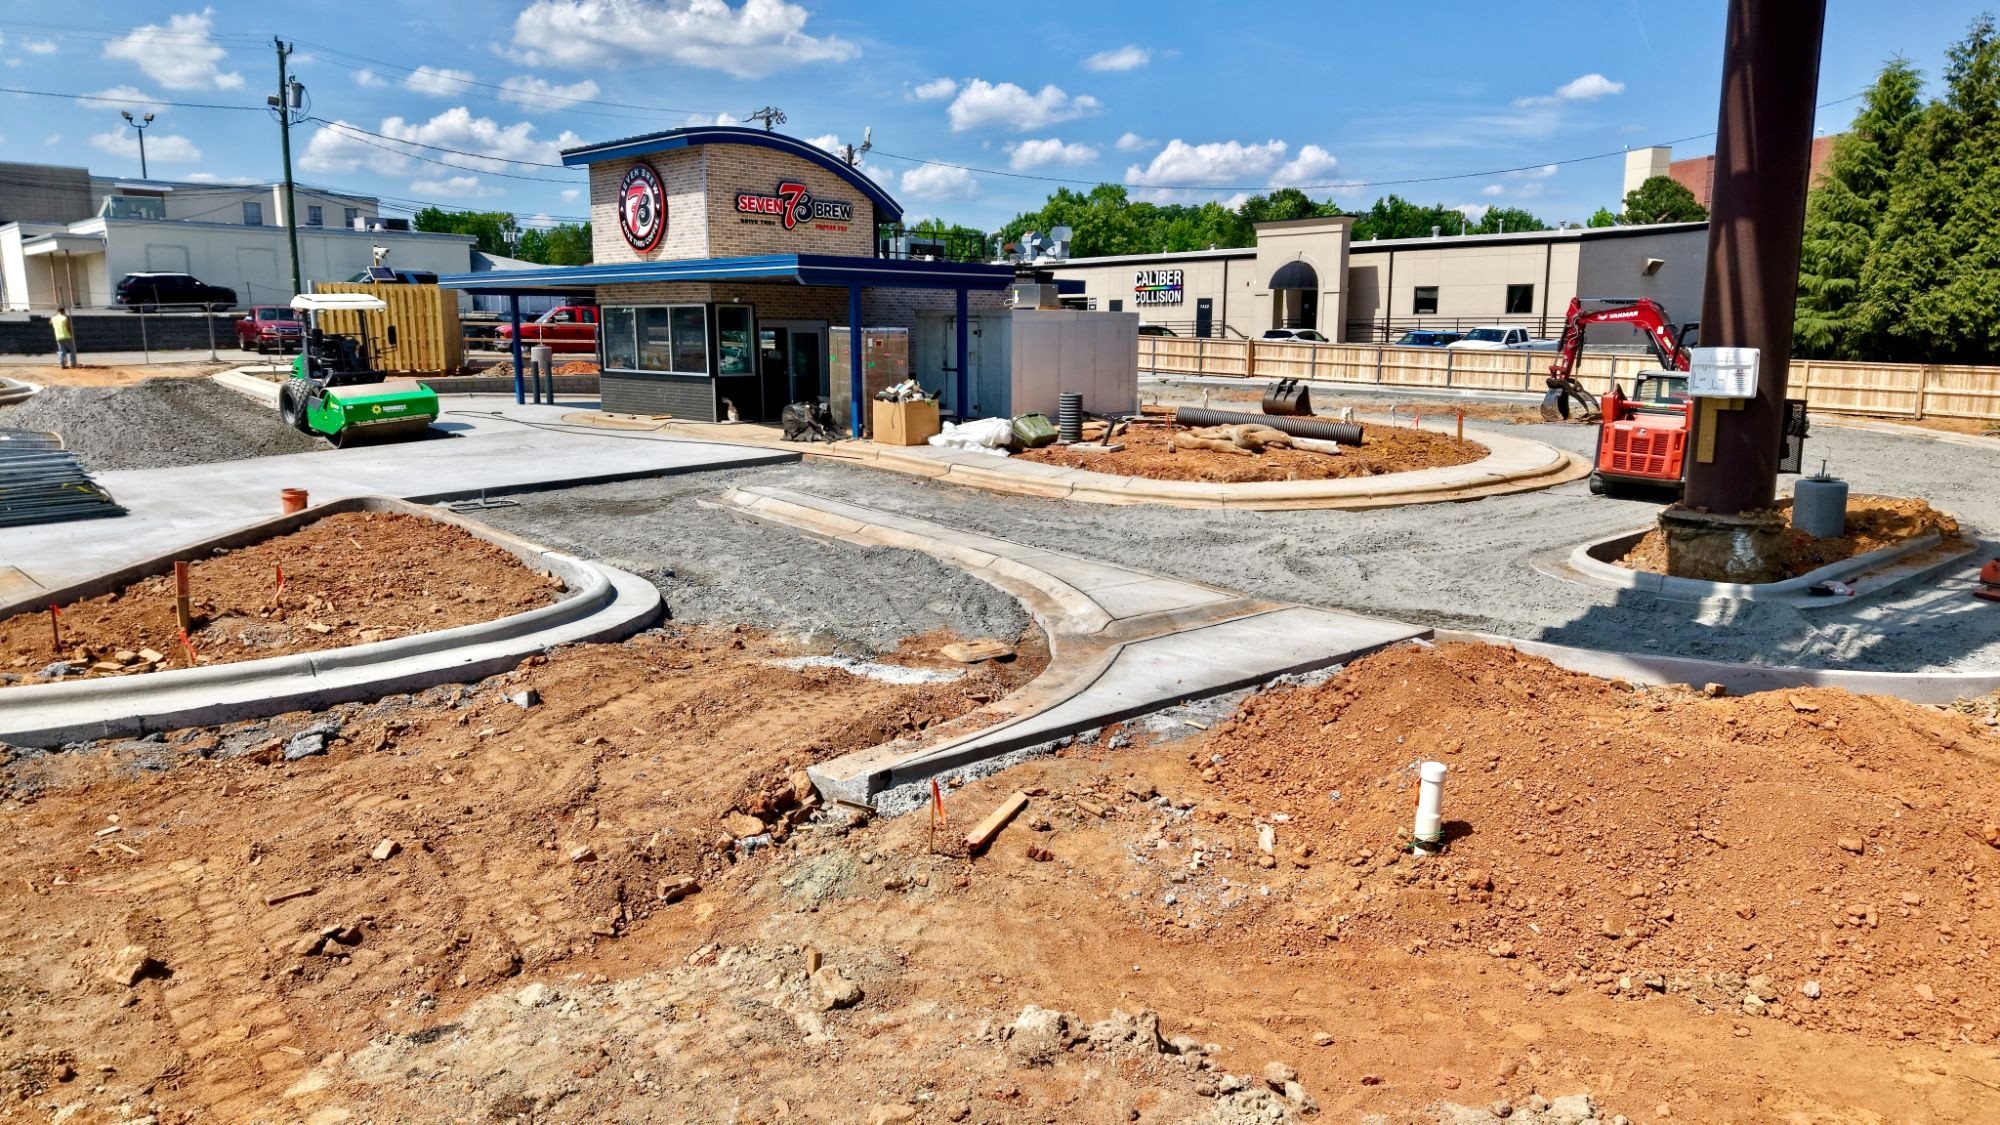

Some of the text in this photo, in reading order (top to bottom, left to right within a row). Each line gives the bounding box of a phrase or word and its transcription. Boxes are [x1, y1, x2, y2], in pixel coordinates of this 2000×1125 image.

[621, 168, 659, 197] SEVEN BREW
[738, 194, 784, 215] SEVEN
[815, 201, 853, 221] BREW
[621, 219, 634, 242] DRIVE
[1135, 270, 1182, 286] CALIBER
[1135, 290, 1182, 303] COLLISION
[1609, 310, 1639, 319] YANMAR
